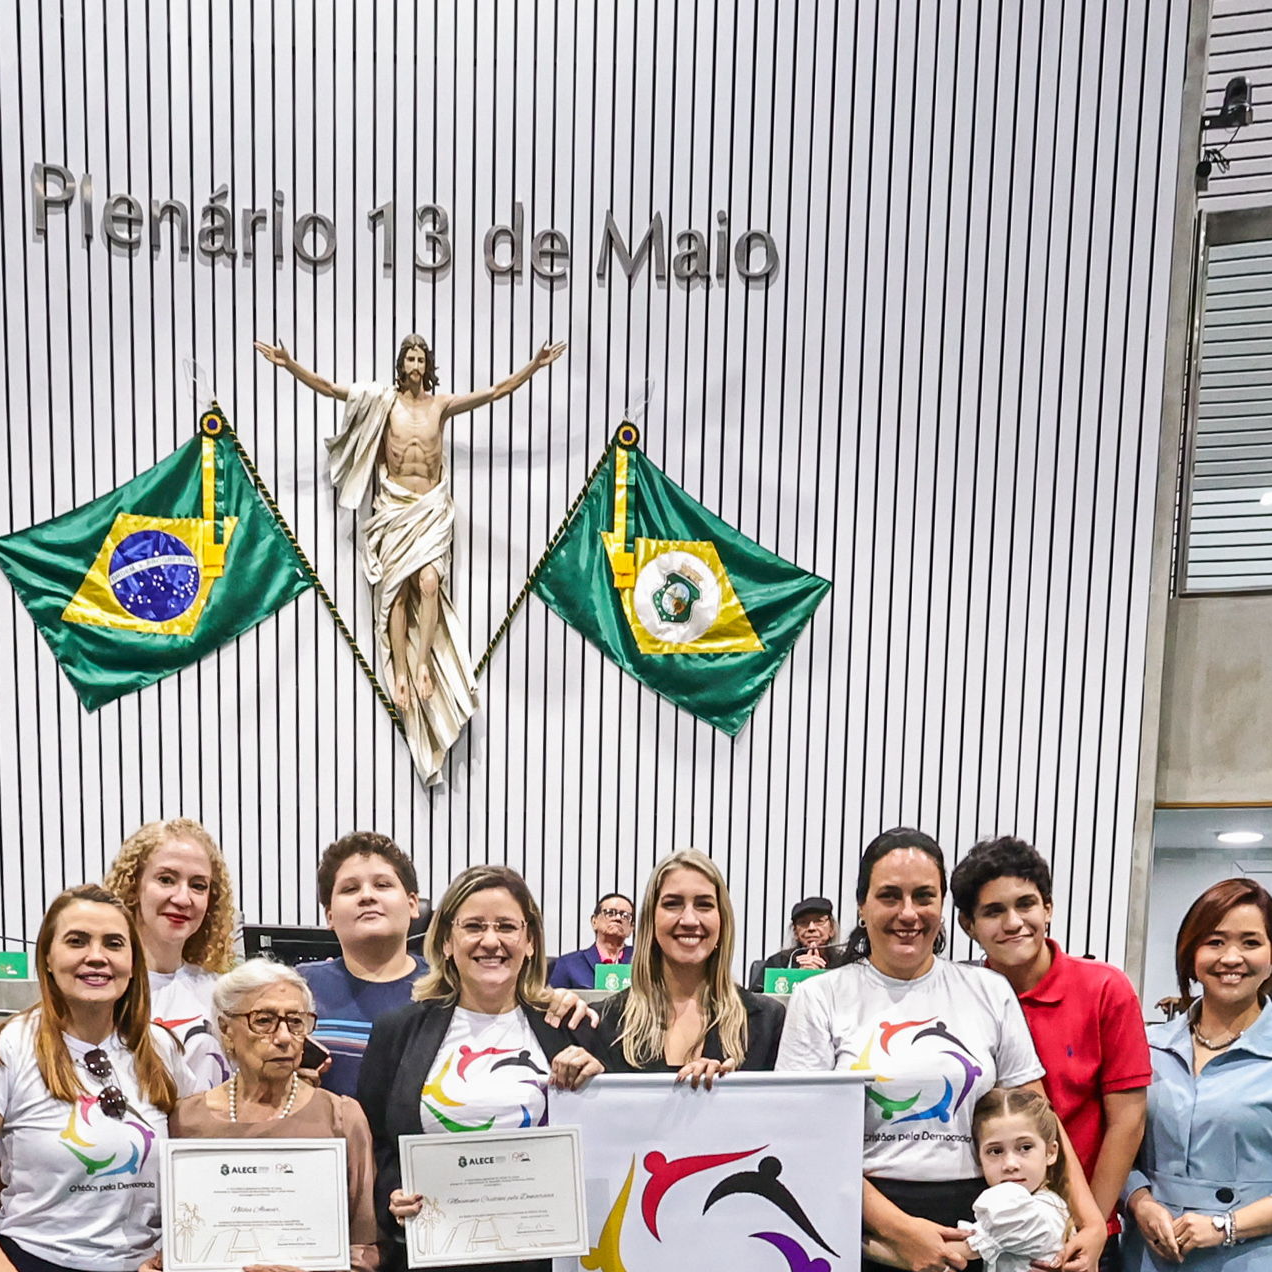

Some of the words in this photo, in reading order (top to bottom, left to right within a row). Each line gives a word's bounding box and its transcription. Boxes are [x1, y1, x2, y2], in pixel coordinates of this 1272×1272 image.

[31, 162, 337, 265] Plenário
[367, 201, 451, 270] 13
[483, 201, 570, 278] de
[596, 209, 780, 279] Maio
[111, 566, 136, 582] ORDEM
[898, 1131, 920, 1142] pela
[469, 1156, 494, 1166] ALECE
[231, 1166, 258, 1174] ALECE
[99, 1184, 116, 1193] pela
